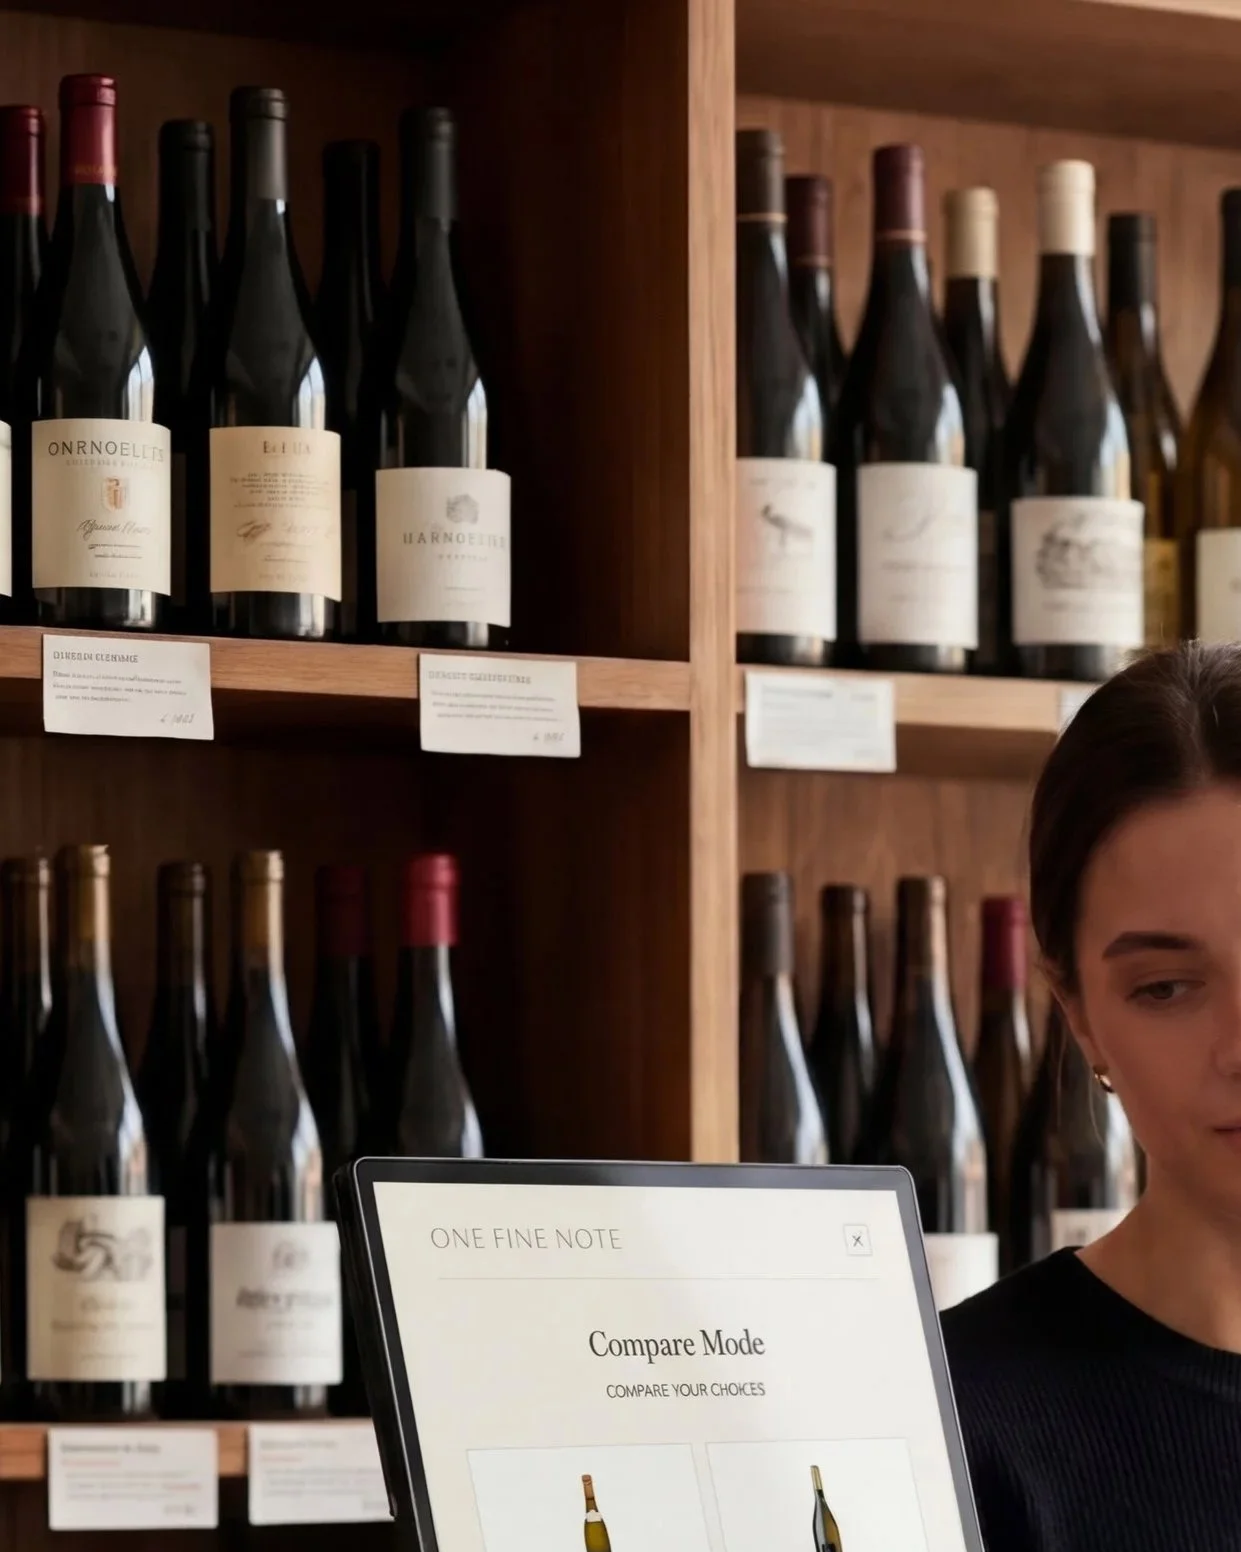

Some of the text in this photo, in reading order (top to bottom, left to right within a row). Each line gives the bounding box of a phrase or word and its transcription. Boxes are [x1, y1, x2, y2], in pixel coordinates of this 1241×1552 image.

[431, 1228, 621, 1249] ONE FINE NOTE
[589, 1329, 765, 1364] Compare Mode
[607, 1383, 765, 1398] COMPARE YOUR CHOICES
